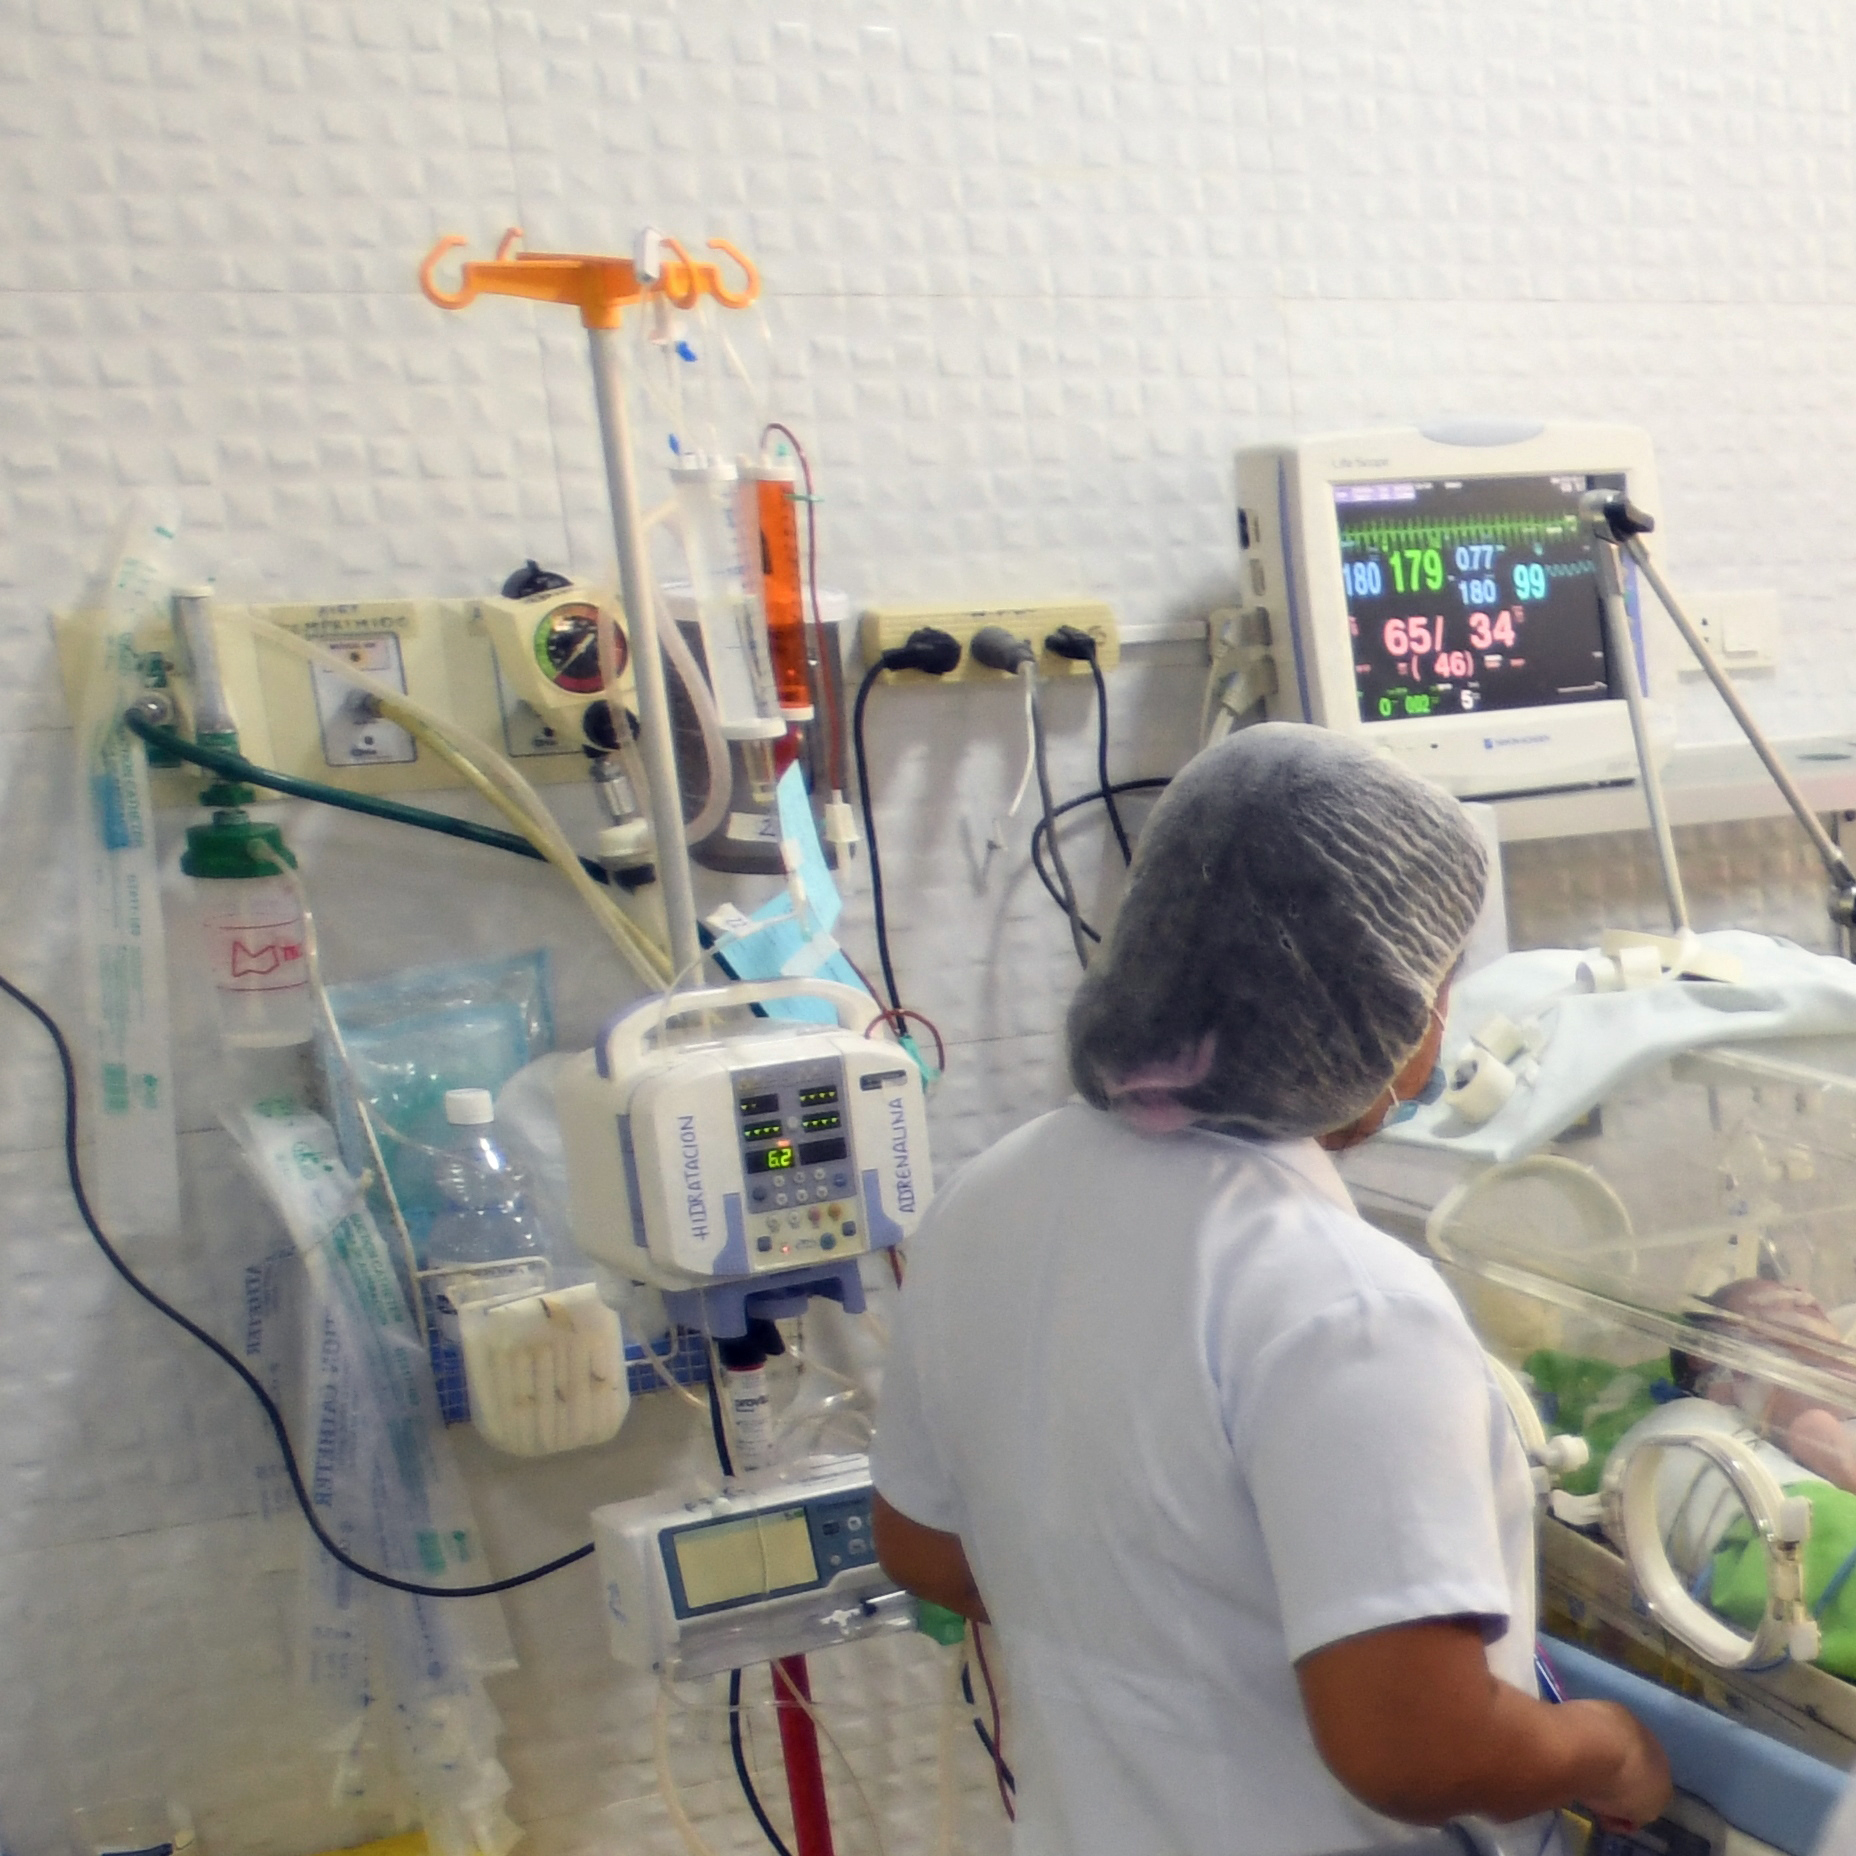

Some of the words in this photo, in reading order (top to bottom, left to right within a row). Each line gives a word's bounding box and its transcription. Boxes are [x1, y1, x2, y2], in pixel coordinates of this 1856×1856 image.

[1389, 549, 1444, 593] 179
[1458, 579, 1497, 605] 180
[1513, 564, 1546, 600] 99
[1469, 610, 1516, 650] 34
[888, 1095, 916, 1213] ADRENALINA
[678, 1115, 711, 1240] HIDRATACION
